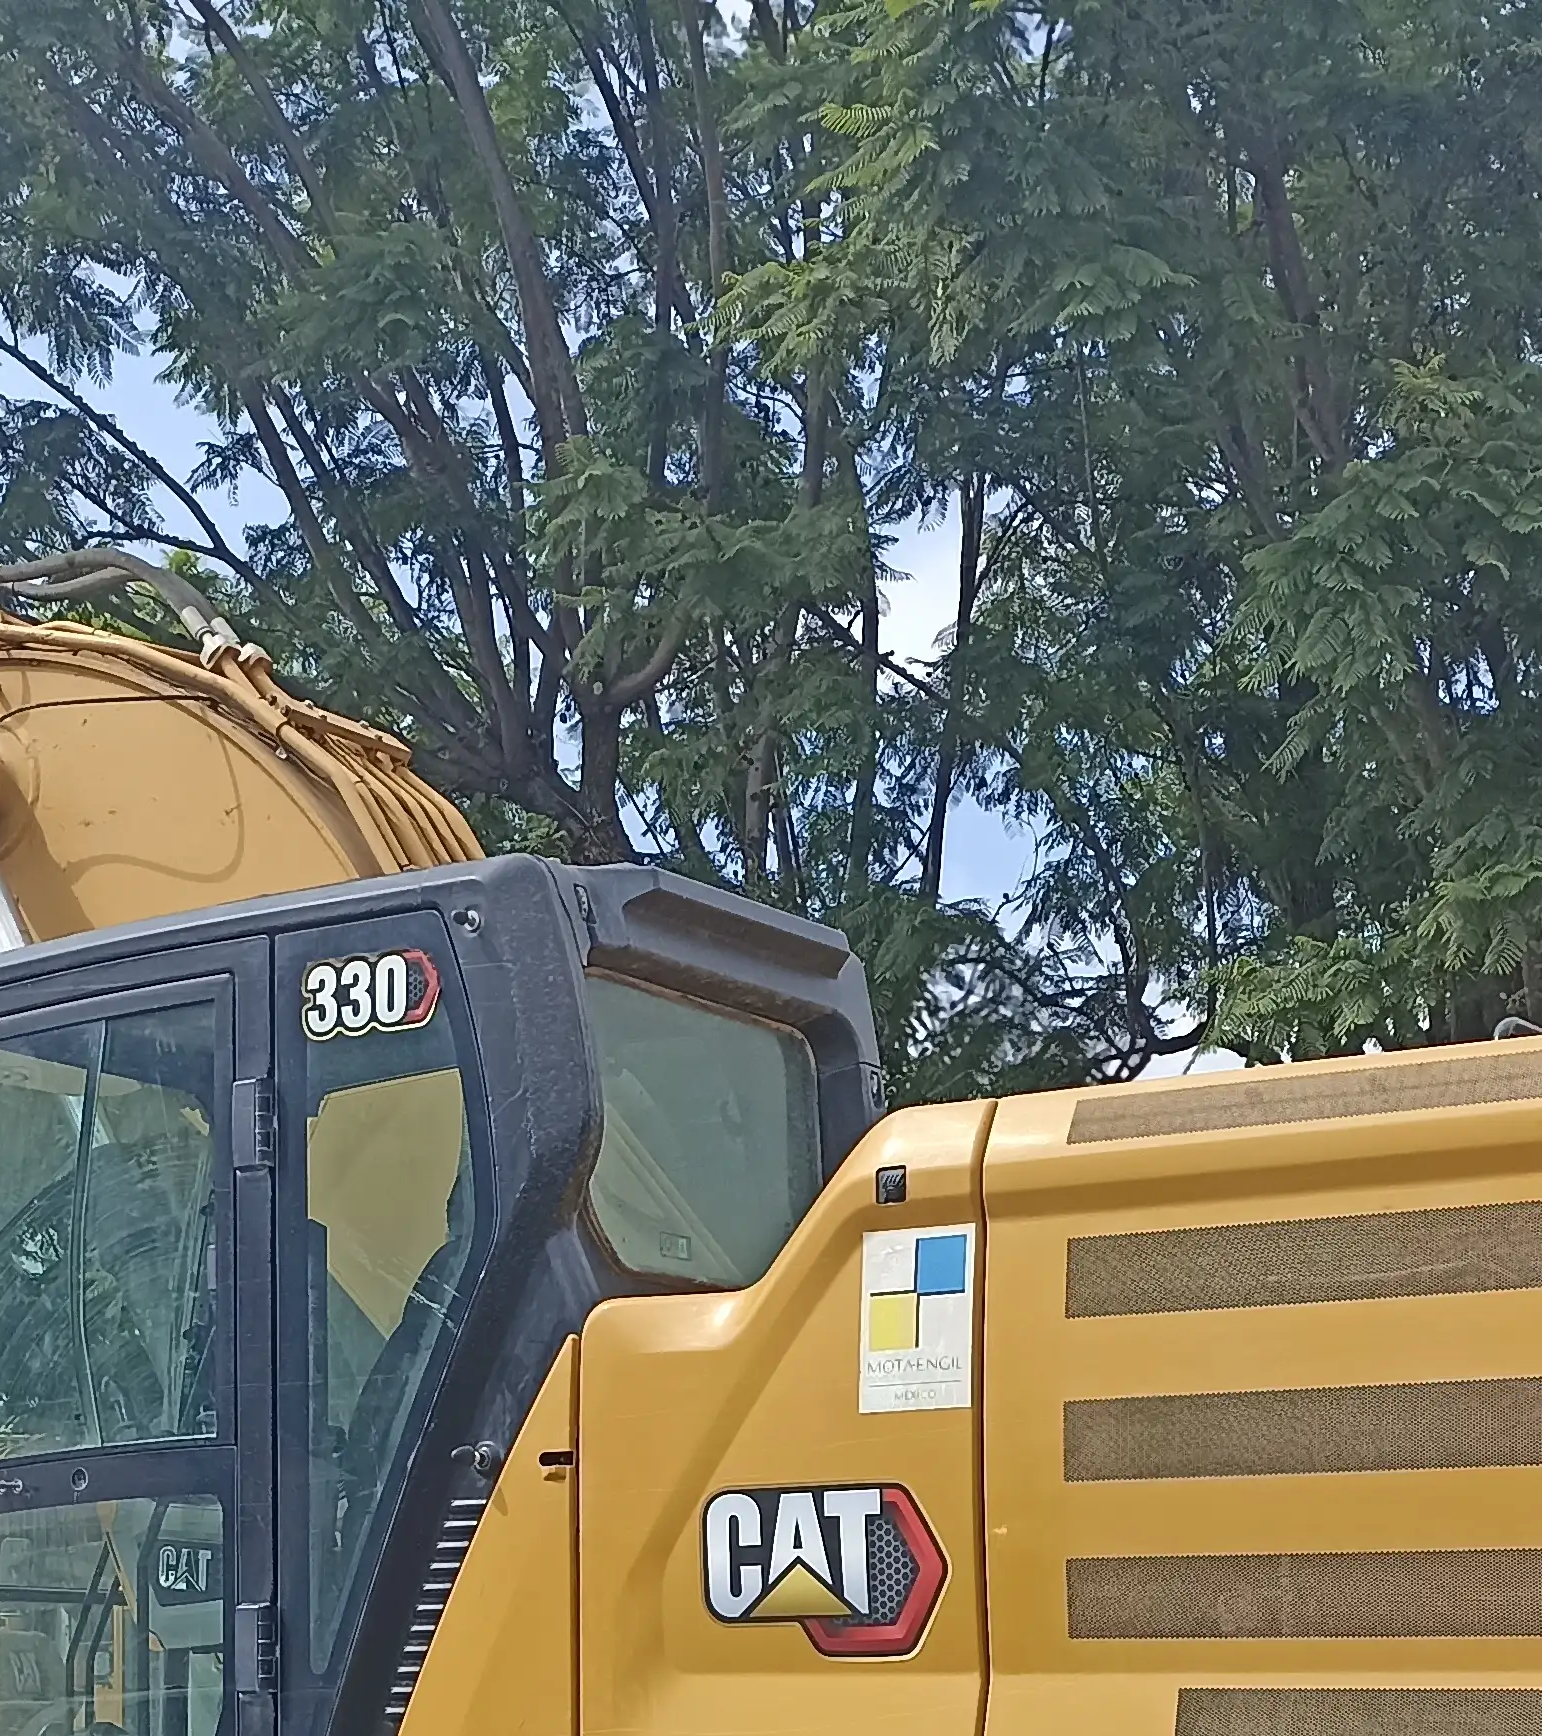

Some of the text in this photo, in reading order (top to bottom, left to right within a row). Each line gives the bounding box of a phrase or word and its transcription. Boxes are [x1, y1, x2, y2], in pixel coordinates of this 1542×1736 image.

[307, 954, 407, 1033] 330
[158, 1545, 212, 1593] CAT
[706, 1488, 882, 1618] CAT
